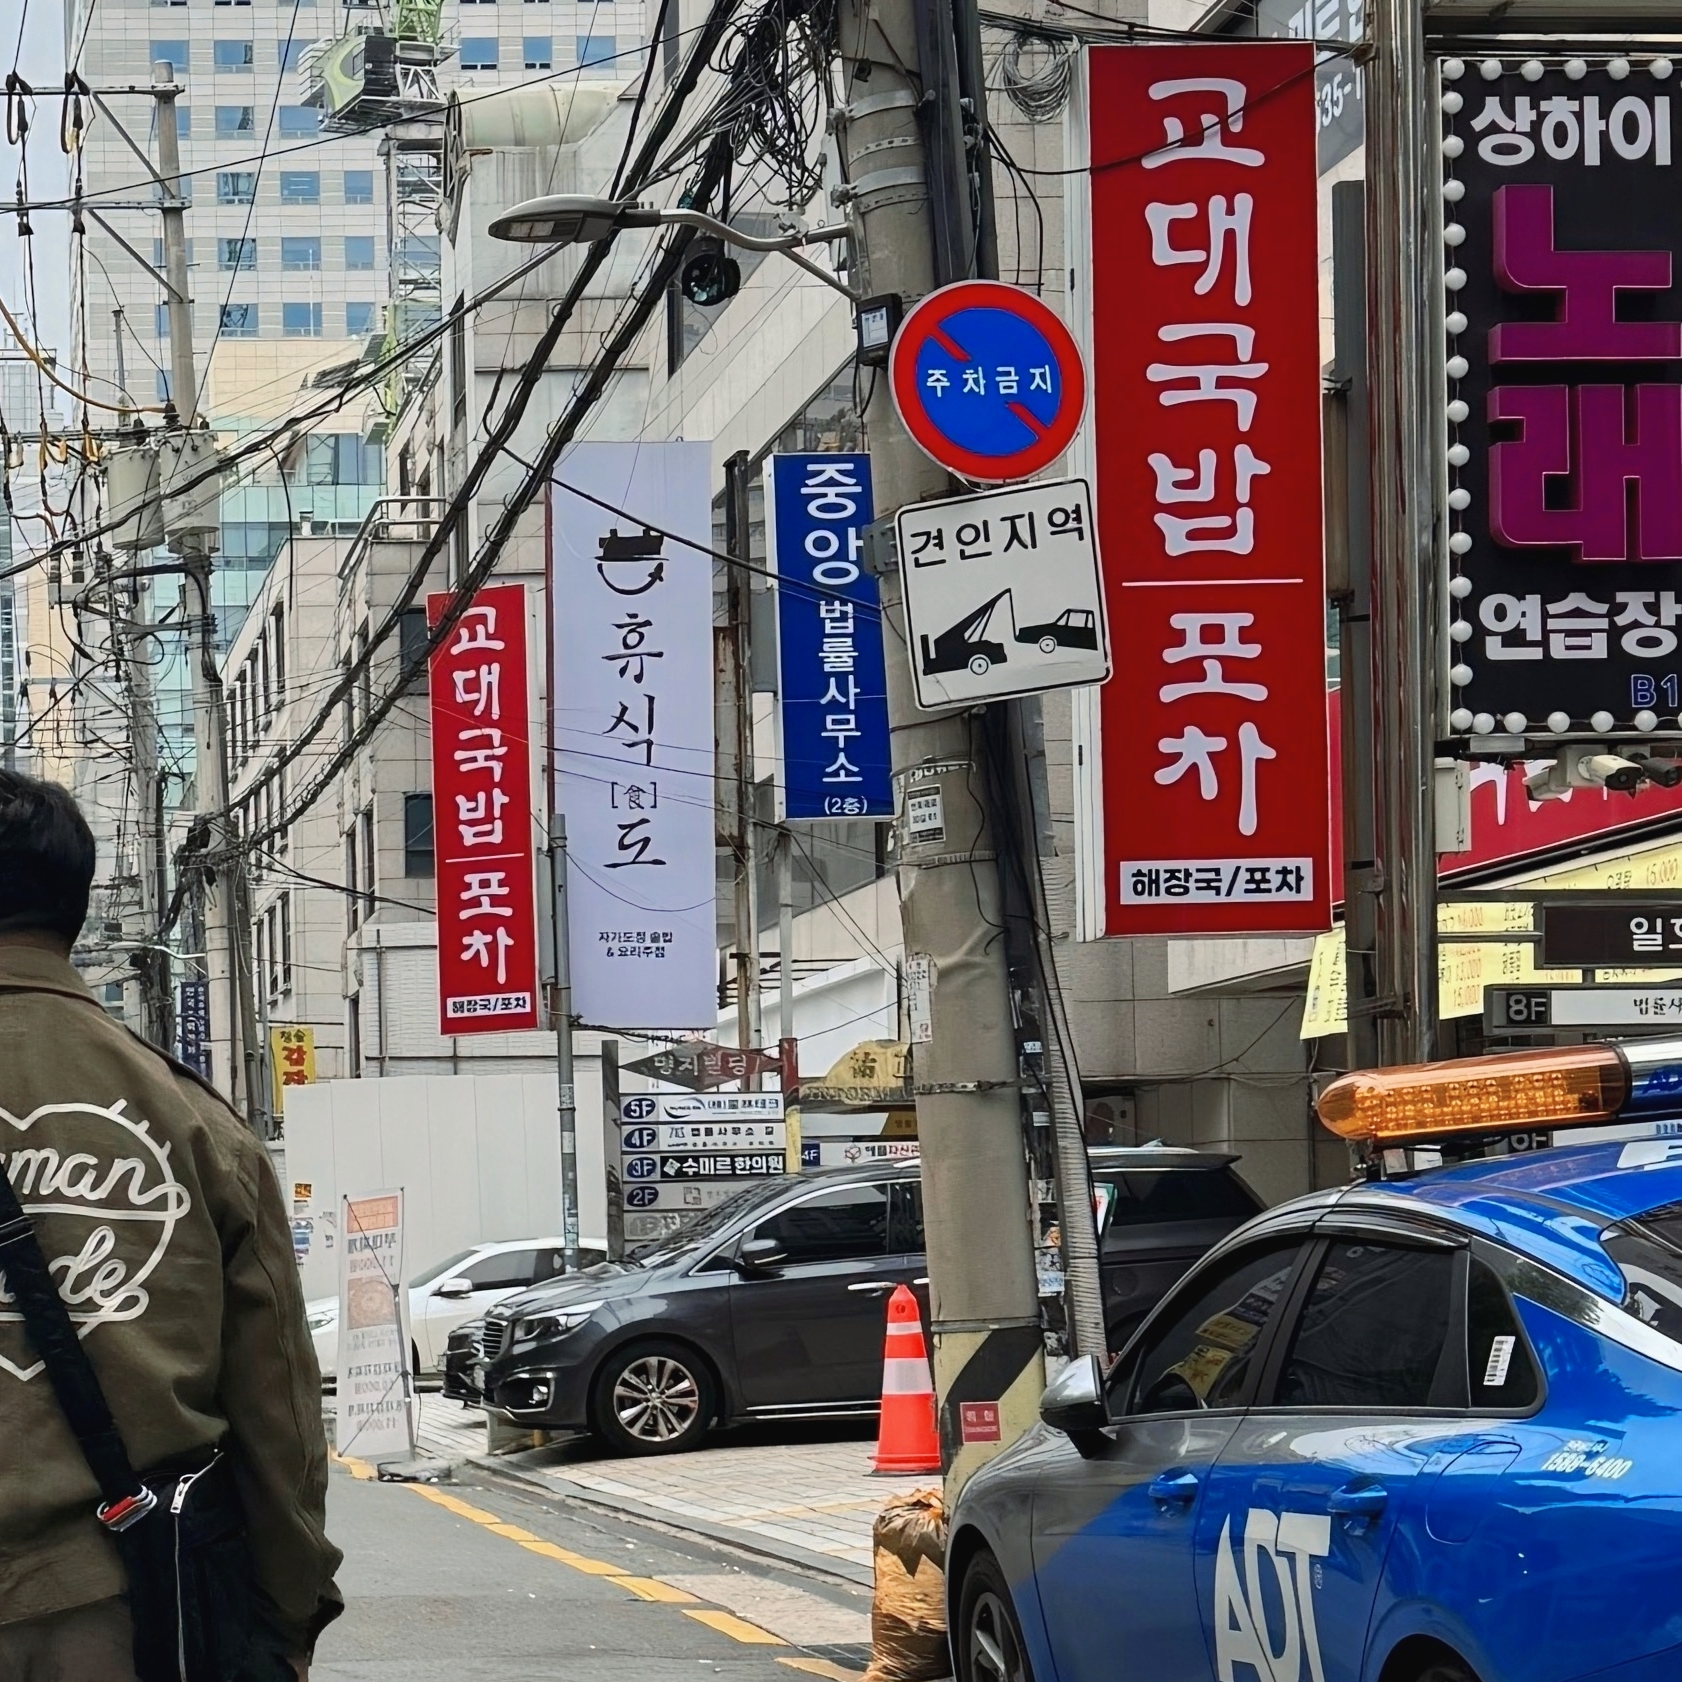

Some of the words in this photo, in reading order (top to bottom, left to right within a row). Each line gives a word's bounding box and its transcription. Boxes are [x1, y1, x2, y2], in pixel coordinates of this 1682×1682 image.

[1470, 96, 1671, 166] 상하이
[1141, 77, 1271, 556] 교대국밥
[926, 364, 1053, 398] 주차금지
[1487, 184, 1682, 561] 노래
[800, 462, 864, 586] 중앙
[910, 502, 1085, 569] 견인지역
[1478, 591, 1682, 661] 연습장
[818, 600, 864, 783] 법률사무소
[1154, 612, 1277, 836] 포차
[1630, 674, 1679, 707] B1
[450, 606, 510, 847] 교대국밥
[1131, 866, 1305, 898] 해장국/포차
[459, 871, 515, 984] 포차
[1508, 994, 1548, 1021] 8F
[630, 1100, 653, 1118] 5F
